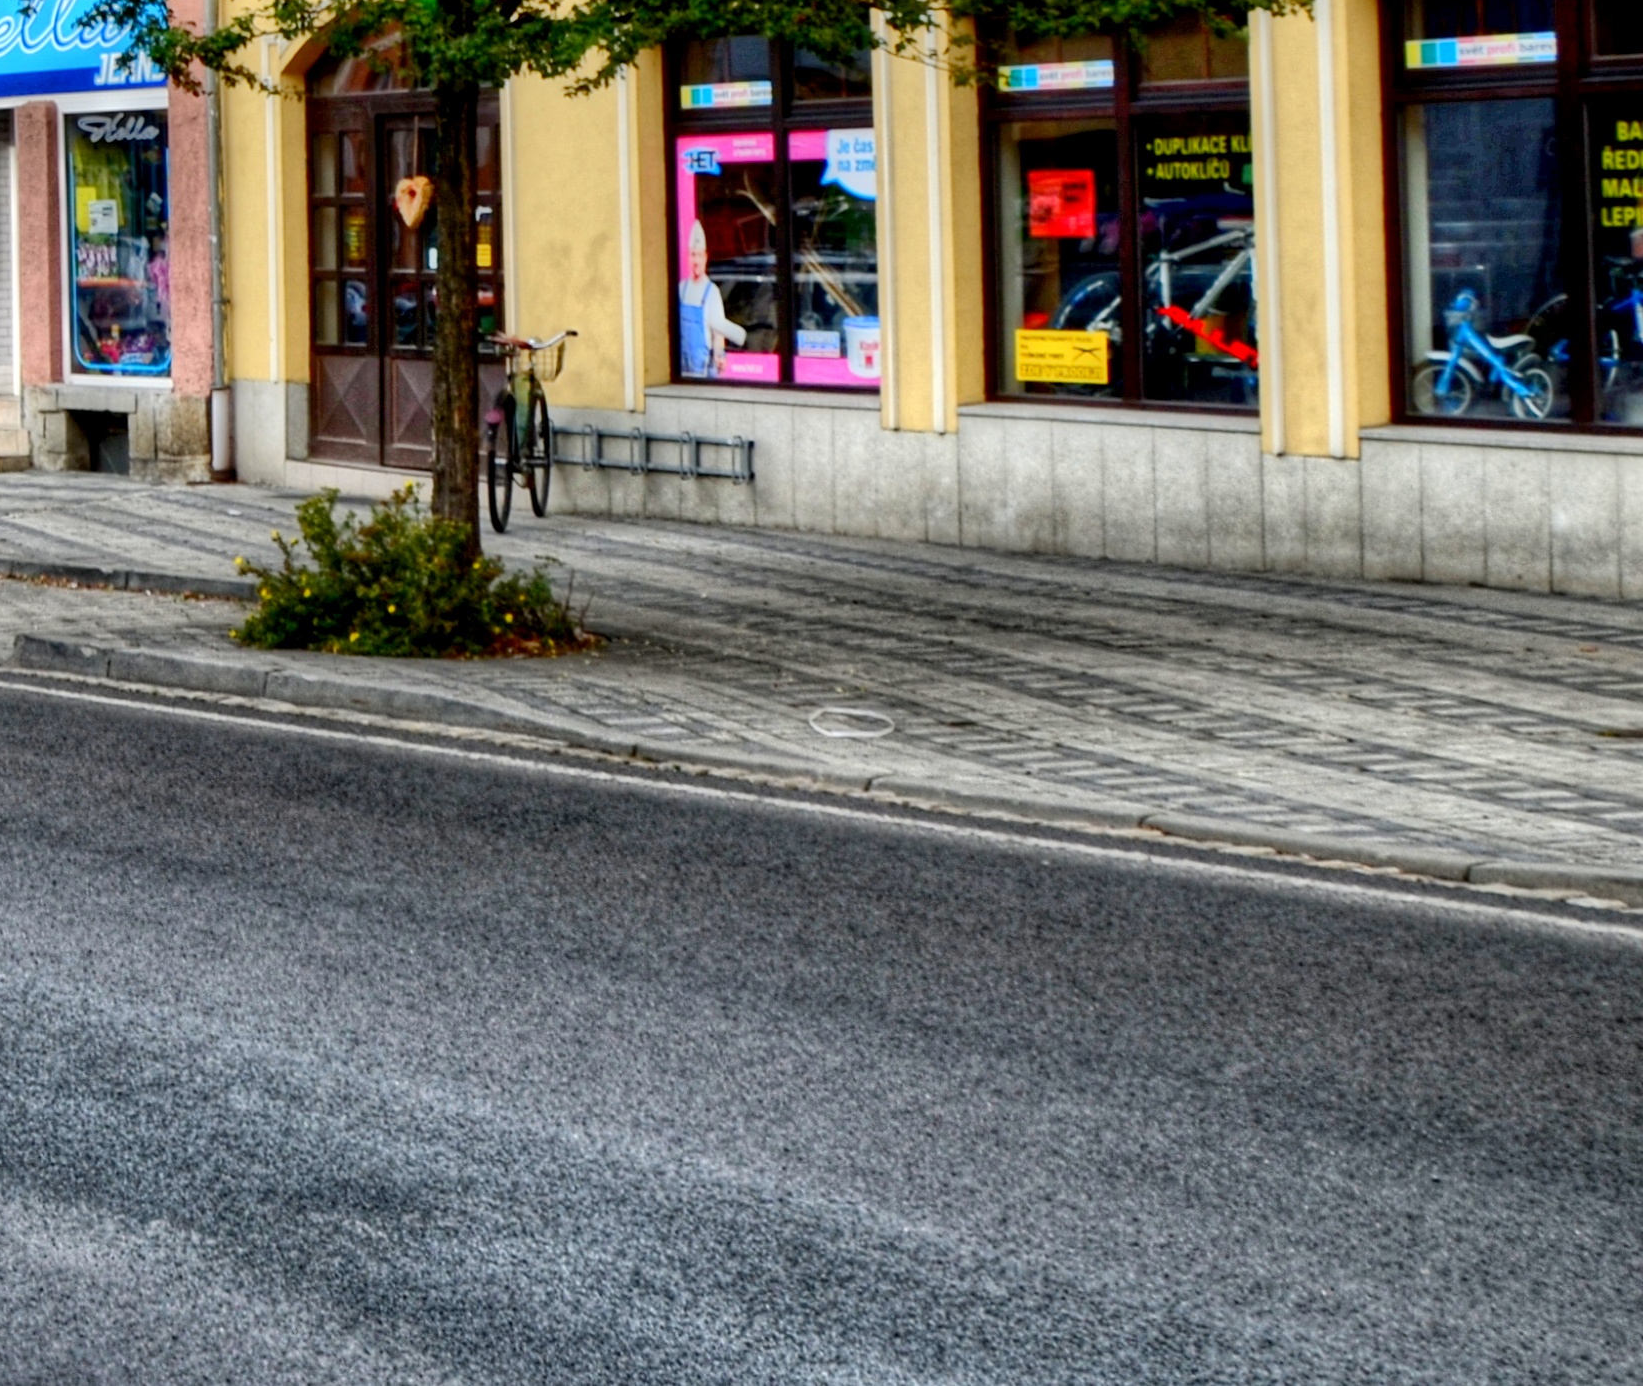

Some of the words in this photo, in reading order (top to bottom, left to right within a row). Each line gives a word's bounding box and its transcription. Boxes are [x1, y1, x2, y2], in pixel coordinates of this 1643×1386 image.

[78, 112, 160, 143] Hella
[1616, 119, 1643, 142] BA
[837, 138, 850, 154] Je
[854, 137, 873, 154] čas
[1154, 134, 1228, 156] DUPLIKACE
[838, 159, 851, 172] na
[1155, 157, 1230, 181] AUTOKLÍČŮ
